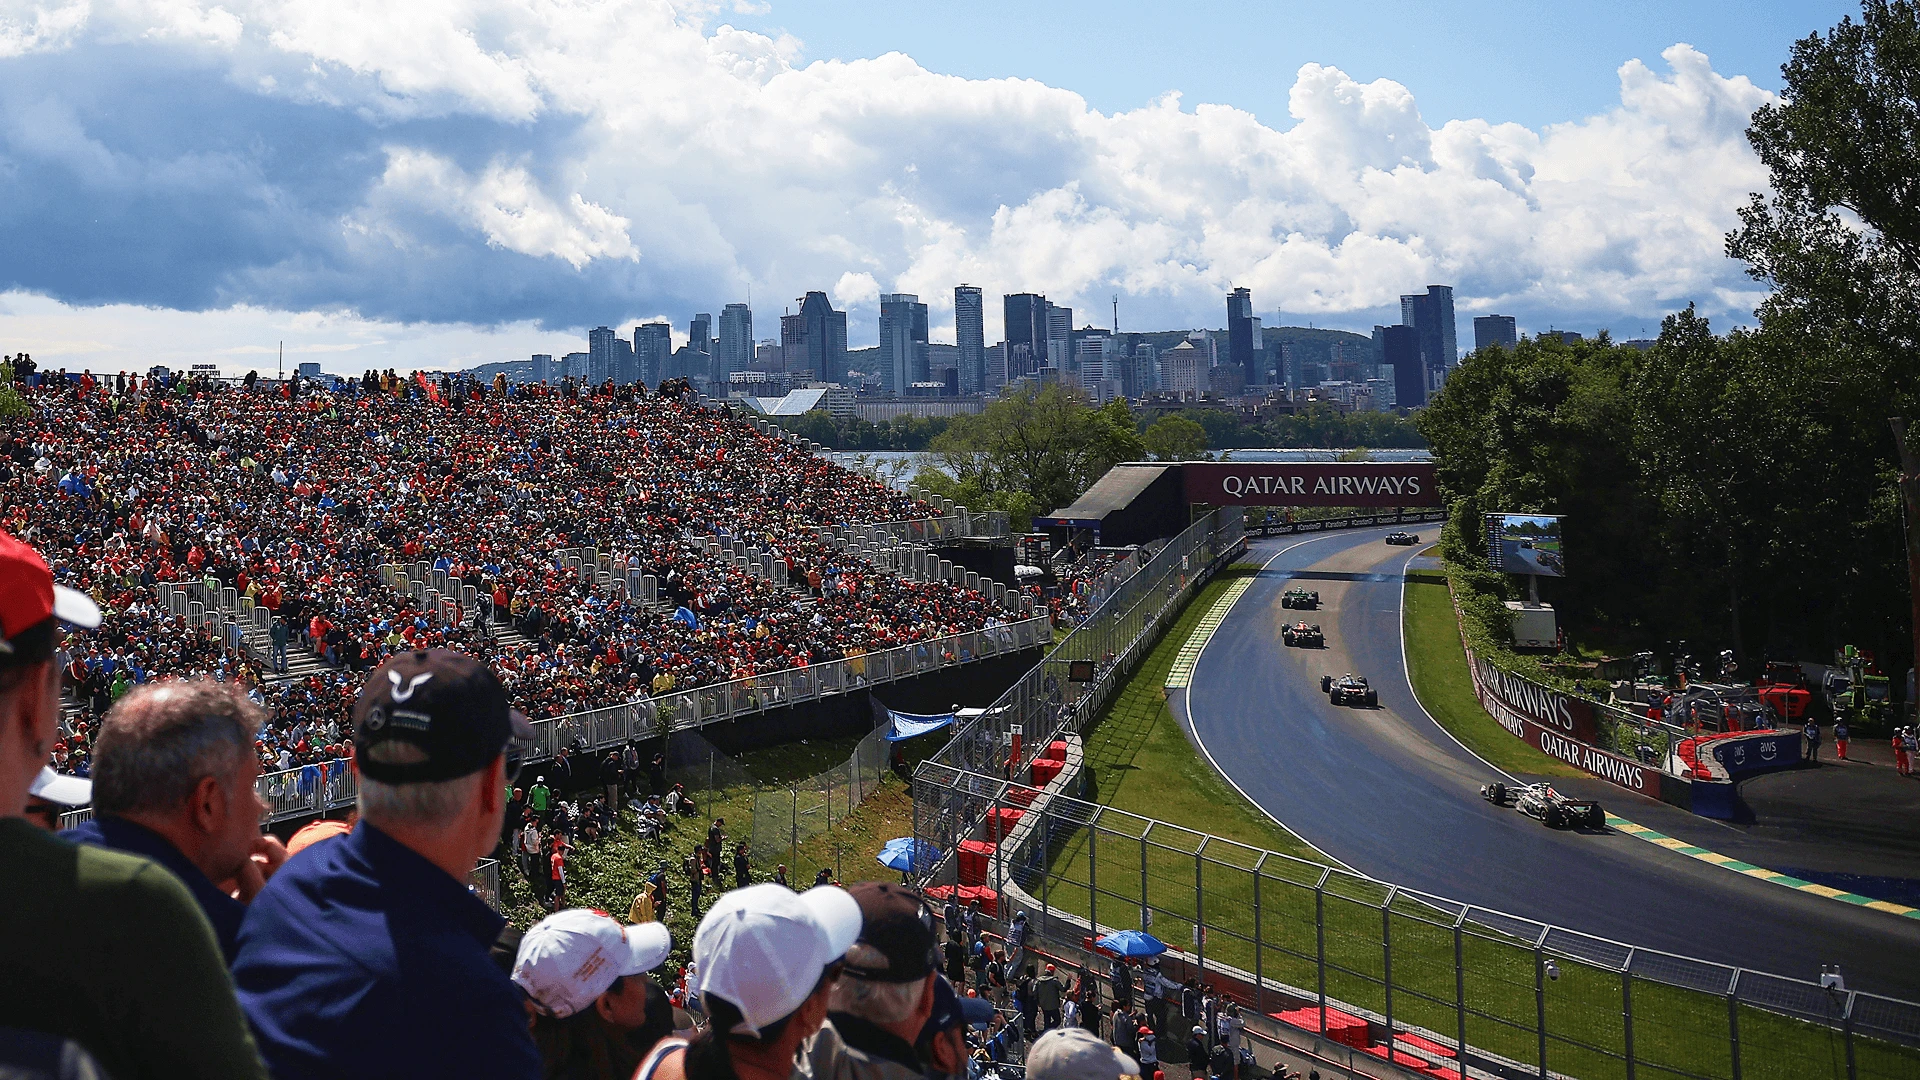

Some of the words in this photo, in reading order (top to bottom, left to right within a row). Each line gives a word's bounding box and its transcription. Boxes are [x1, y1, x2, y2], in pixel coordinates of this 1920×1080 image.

[1222, 475, 1306, 498] QATAR
[1313, 476, 1421, 495] AIRWAYS
[1503, 672, 1573, 731] AIRWAYS
[1541, 731, 1581, 766] QATAR
[1582, 749, 1643, 789] AIRWAYS
[1760, 742, 1777, 753] aws
